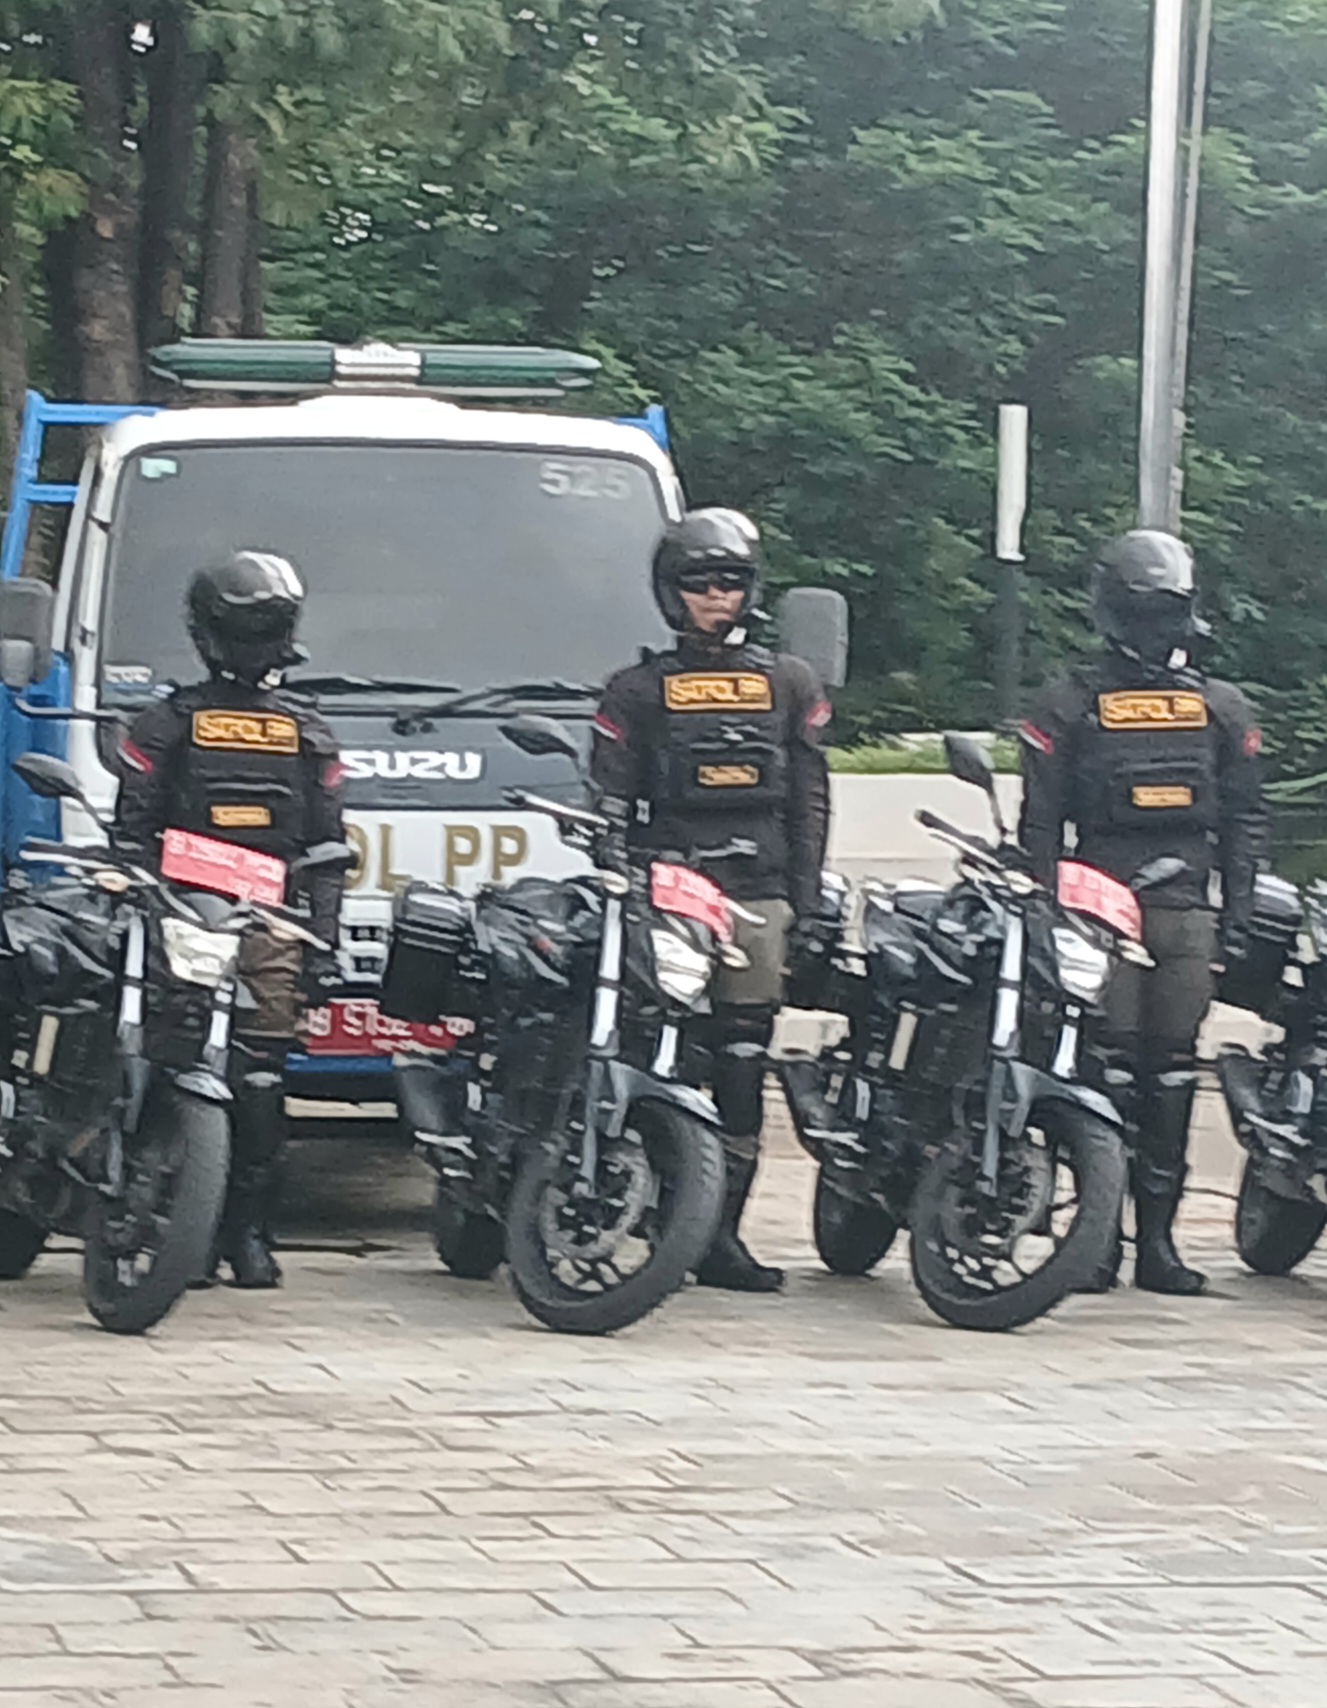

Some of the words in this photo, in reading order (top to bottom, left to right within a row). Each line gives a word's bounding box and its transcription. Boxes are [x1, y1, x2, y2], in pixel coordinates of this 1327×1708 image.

[539, 461, 632, 500] 525
[339, 749, 482, 780] SUZU
[345, 823, 412, 892] OL
[444, 824, 528, 886] PP
